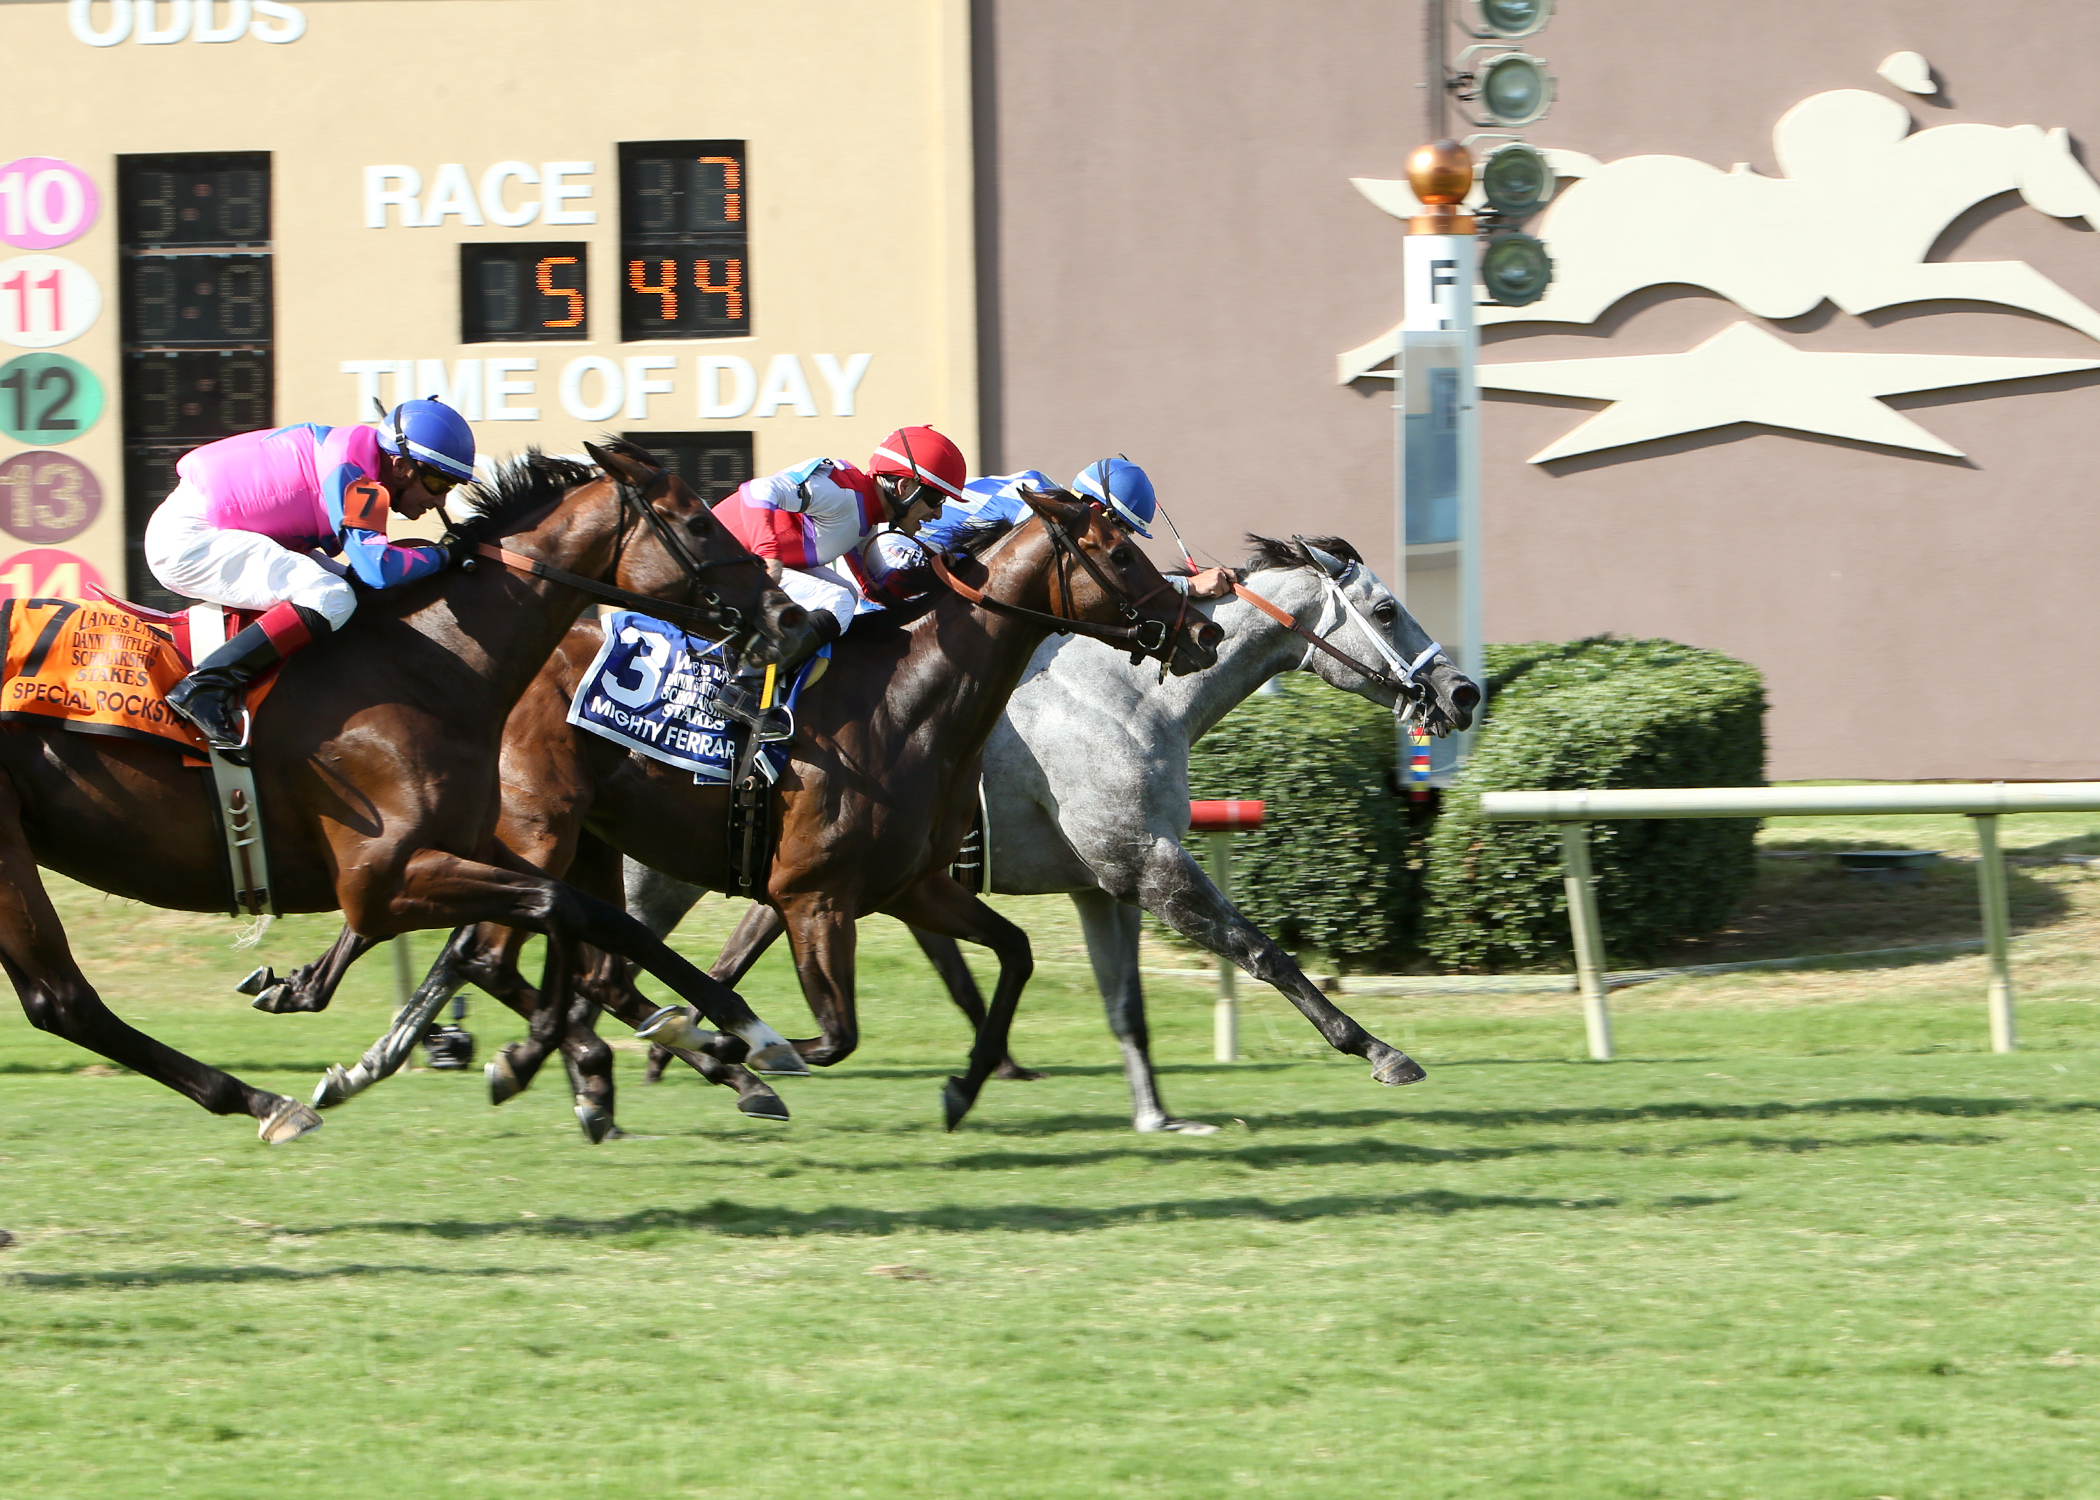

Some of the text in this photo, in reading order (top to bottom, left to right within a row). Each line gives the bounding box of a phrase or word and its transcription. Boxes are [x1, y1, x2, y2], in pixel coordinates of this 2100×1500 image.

[68, 0, 307, 47] ODDS
[0, 168, 86, 236] 10
[363, 160, 597, 228] RACE
[700, 156, 741, 222] 7
[0, 268, 66, 333] 11
[536, 257, 743, 327] 5 44
[0, 366, 82, 431] 12
[340, 352, 874, 423] TIME OF DAY
[0, 463, 88, 529] 13
[356, 486, 379, 519] 7
[18, 598, 81, 677] 7
[73, 631, 107, 651] DANNY
[79, 609, 130, 631] LANE'S
[71, 649, 157, 671] SCHOLARSHIP
[75, 667, 149, 688] STAKES
[601, 626, 671, 709] 3
[13, 682, 92, 711] SPECIAL
[590, 695, 665, 742] MIGHTY
[661, 702, 727, 732] STAKES
